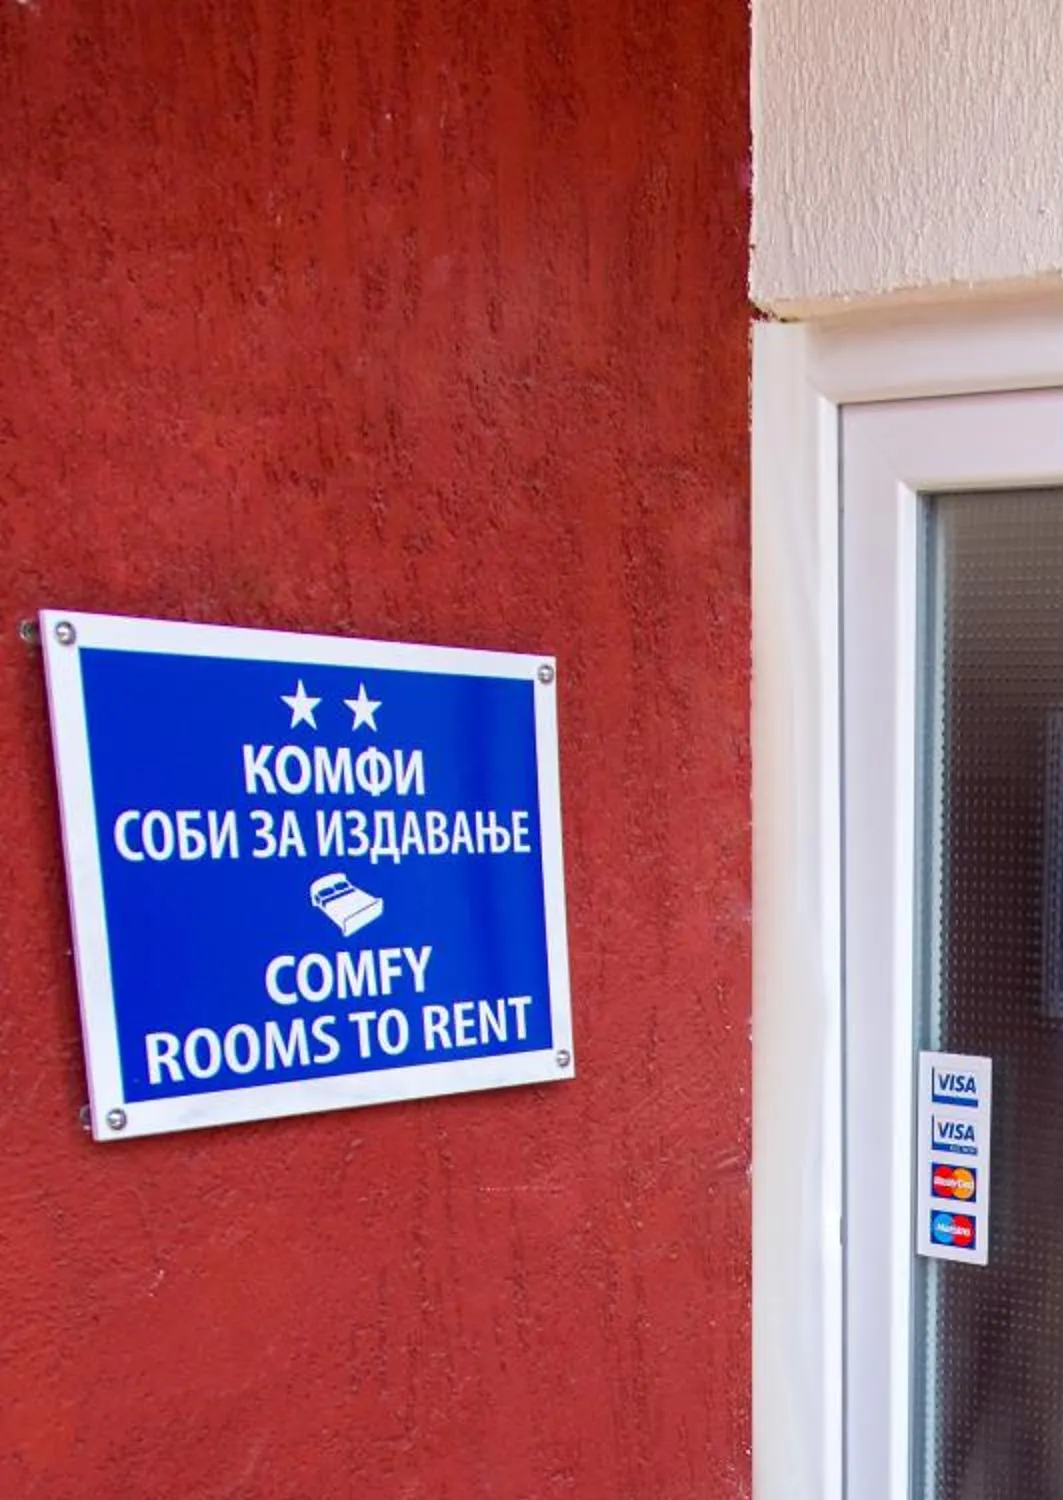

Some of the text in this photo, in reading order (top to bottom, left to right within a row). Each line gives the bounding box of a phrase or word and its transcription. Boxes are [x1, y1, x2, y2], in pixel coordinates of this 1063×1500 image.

[244, 745, 424, 796] КОМФИ
[115, 810, 531, 864] СОБИ ЗА ИЗДАВАЊЕ
[266, 946, 432, 1005] COMFY
[145, 996, 532, 1084] ROOMS TO RENT
[938, 1073, 976, 1094] VISA
[938, 1121, 975, 1142] VISA
